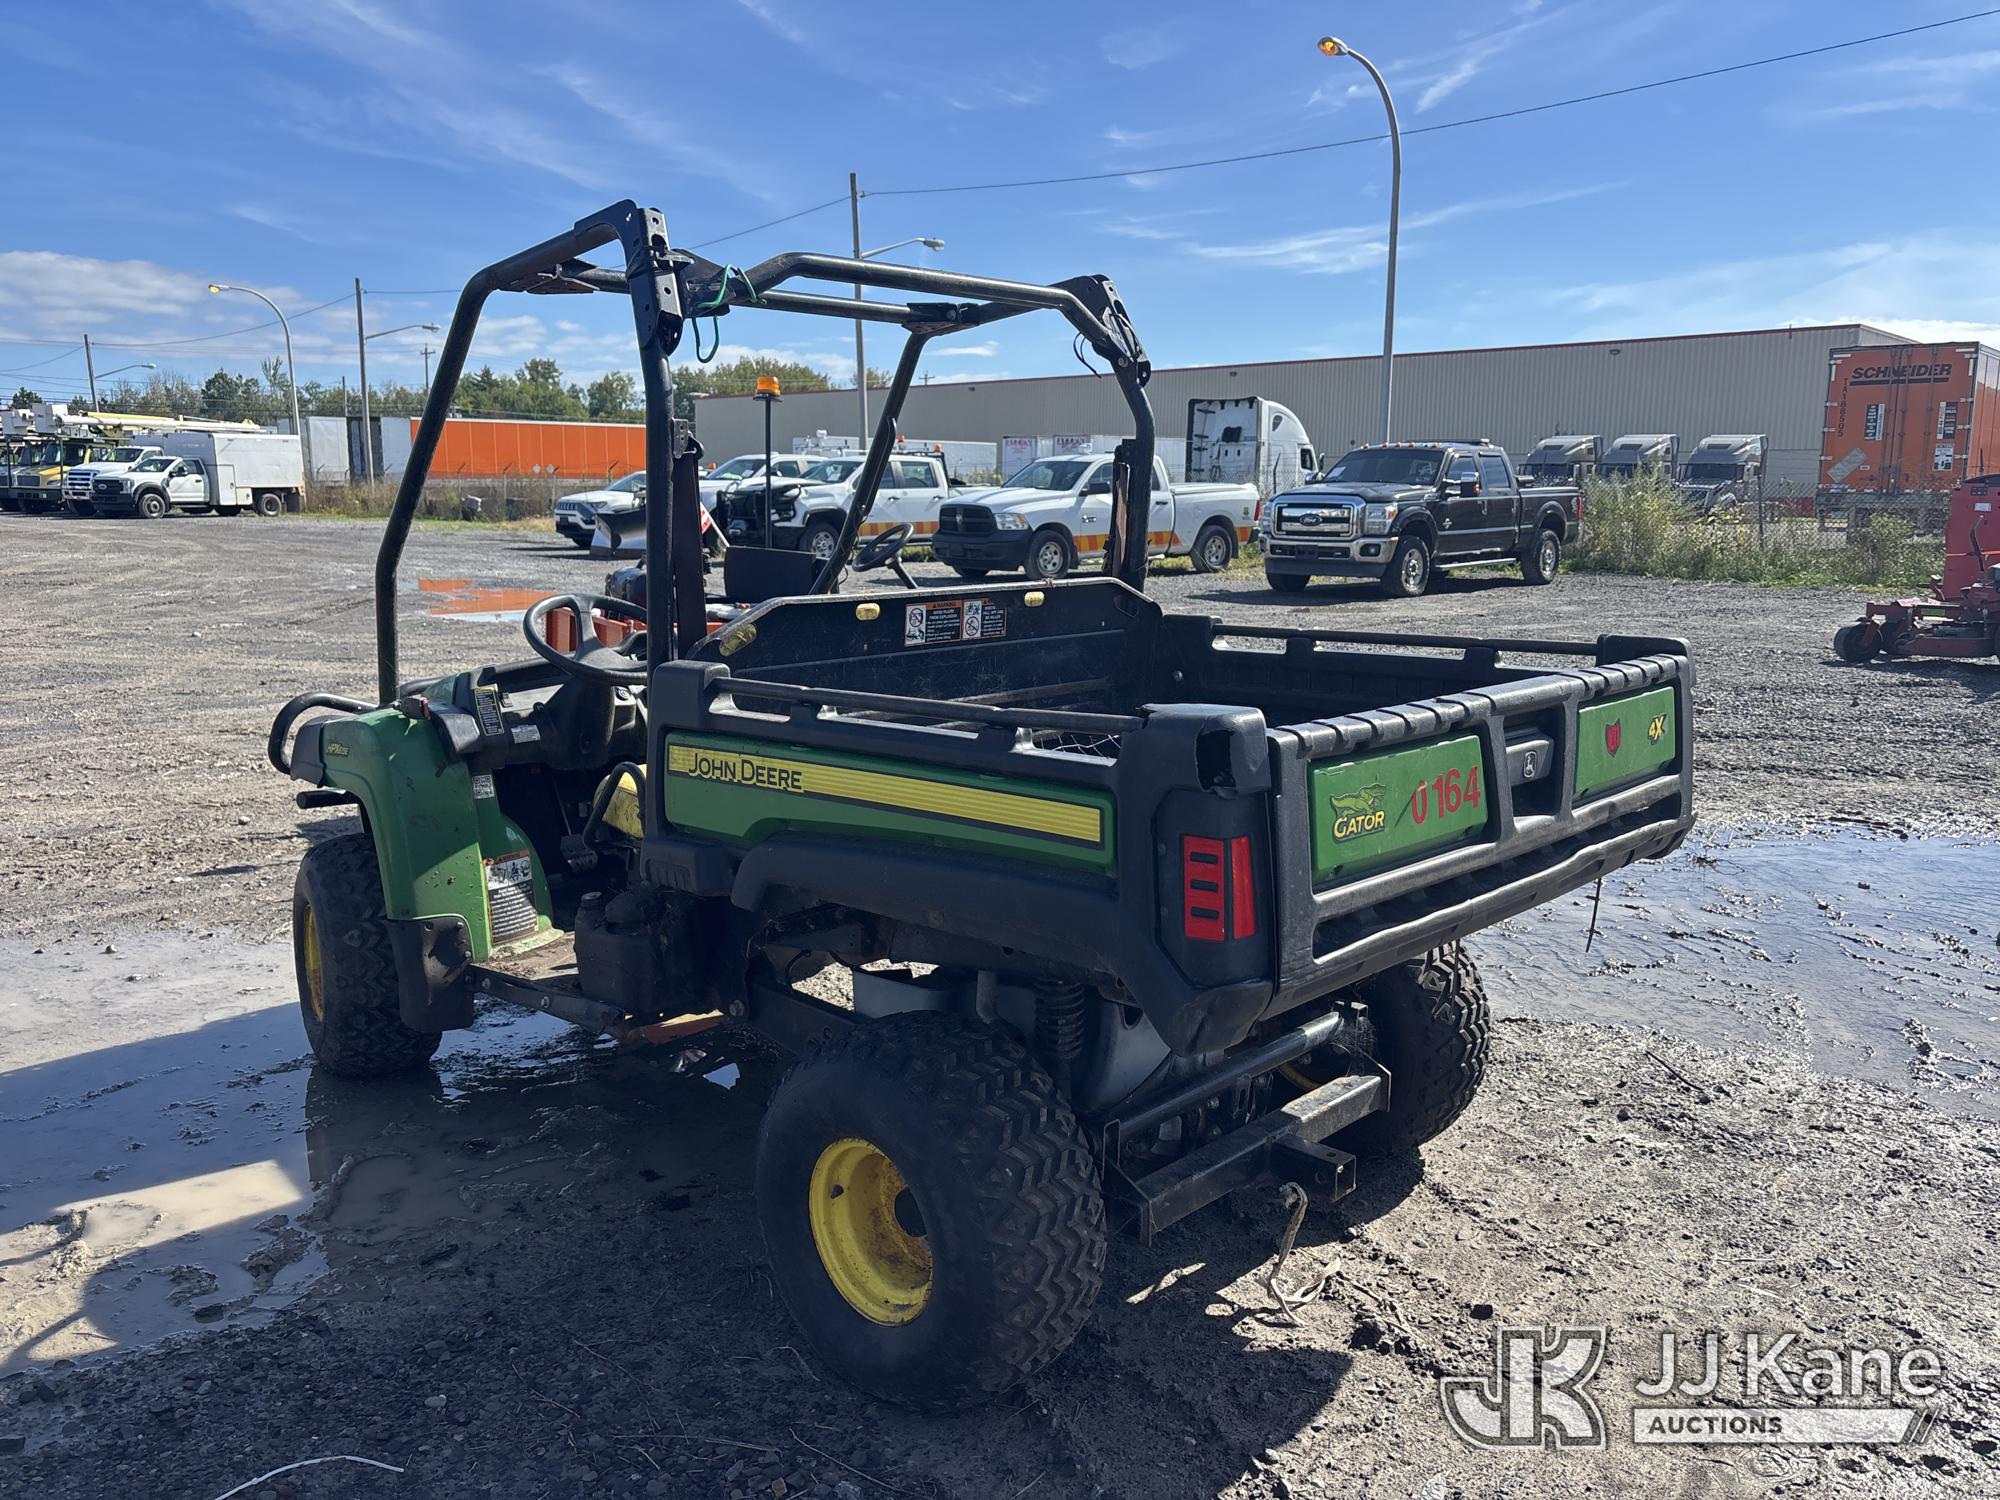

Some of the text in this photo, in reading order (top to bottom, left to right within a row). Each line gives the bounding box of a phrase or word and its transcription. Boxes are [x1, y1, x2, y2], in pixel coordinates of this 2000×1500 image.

[1852, 363, 1953, 380] SCHNEIDER
[1648, 715, 1667, 741] 4X
[689, 753, 803, 790] JOHN DEERE
[1334, 811, 1385, 840] GATOR
